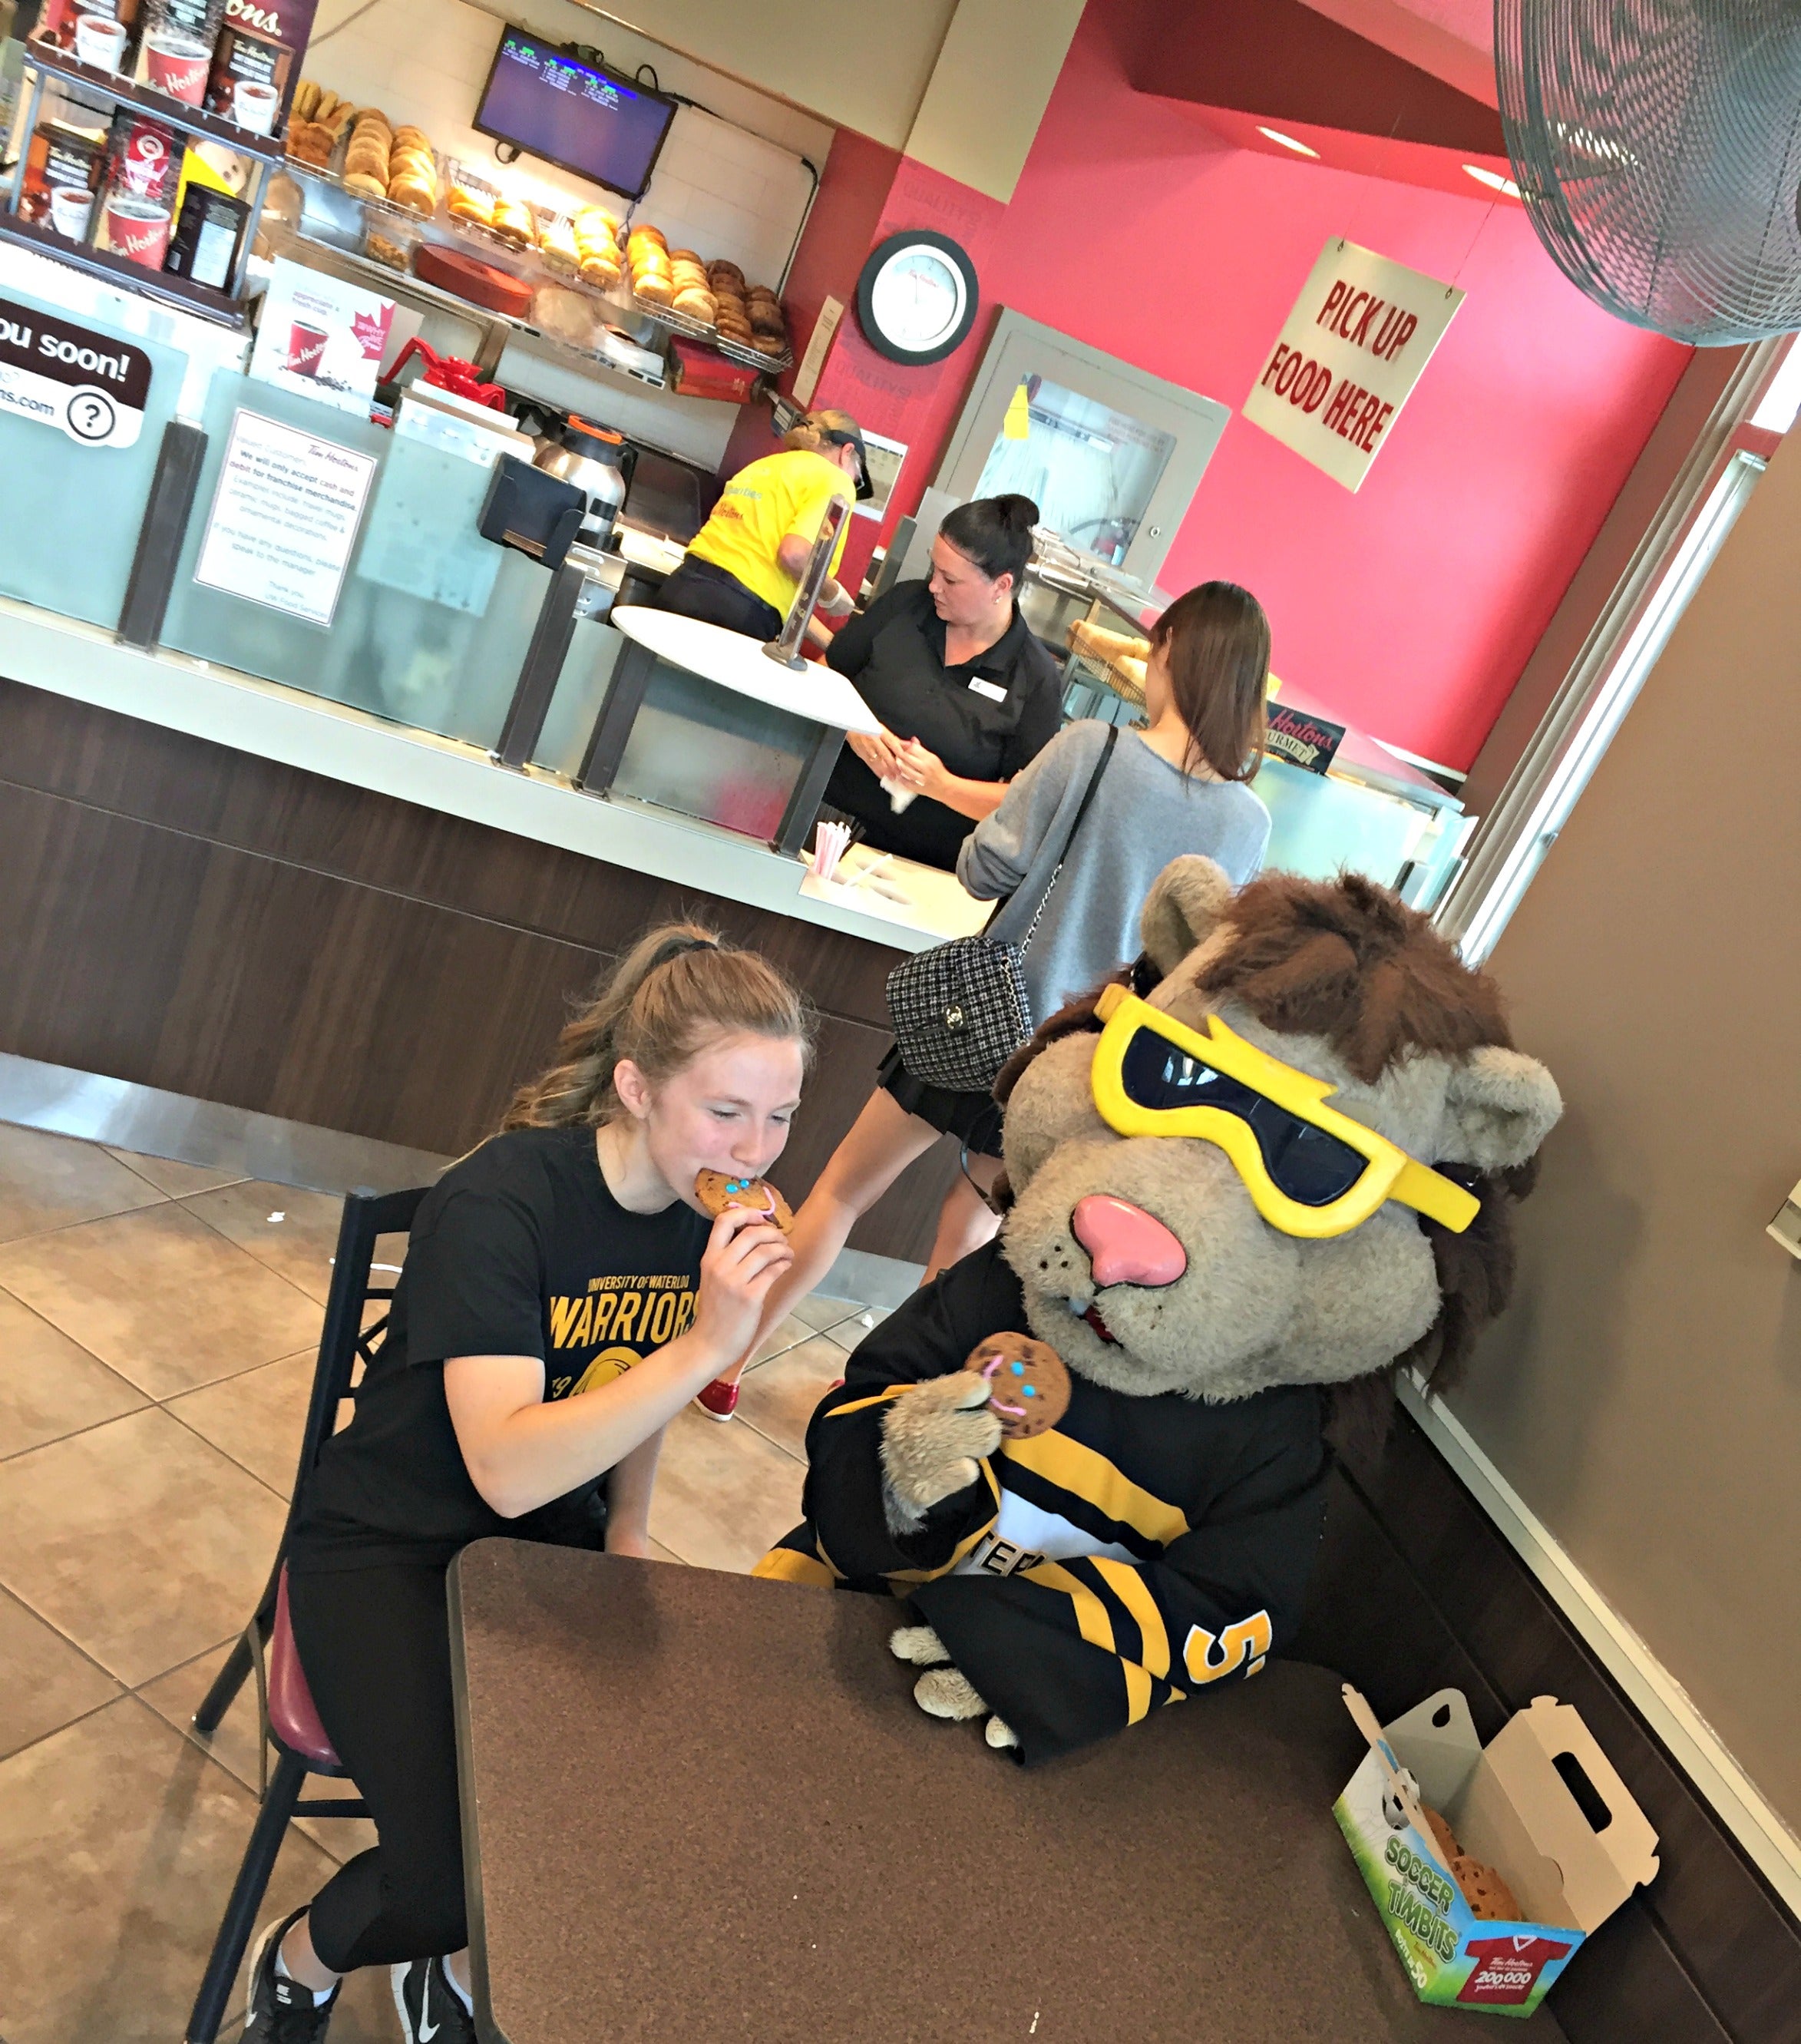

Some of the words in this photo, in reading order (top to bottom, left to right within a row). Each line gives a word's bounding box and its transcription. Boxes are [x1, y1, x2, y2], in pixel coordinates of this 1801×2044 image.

[1316, 279, 1385, 347] PICK
[1372, 306, 1419, 362] UP
[38, 334, 131, 382] soon!
[1261, 342, 1333, 414] FOOD
[1322, 379, 1394, 454] HERE
[229, 459, 251, 473] debit
[253, 468, 264, 478] for
[266, 473, 303, 491] franchise
[240, 450, 253, 460] We
[255, 455, 270, 466] will
[271, 461, 289, 474] only
[290, 468, 318, 484] accept
[319, 479, 337, 491] cash
[339, 486, 355, 497] and
[307, 443, 324, 458] Tim
[324, 450, 359, 471] Hortons
[1268, 708, 1333, 752] Hortons
[588, 1275, 639, 1292] UNIVERSITY
[636, 1275, 648, 1290] OF
[647, 1275, 690, 1289] WATERLOO
[1385, 1835, 1455, 1914] SOCCER
[1389, 1879, 1459, 1963] TIMBITS
